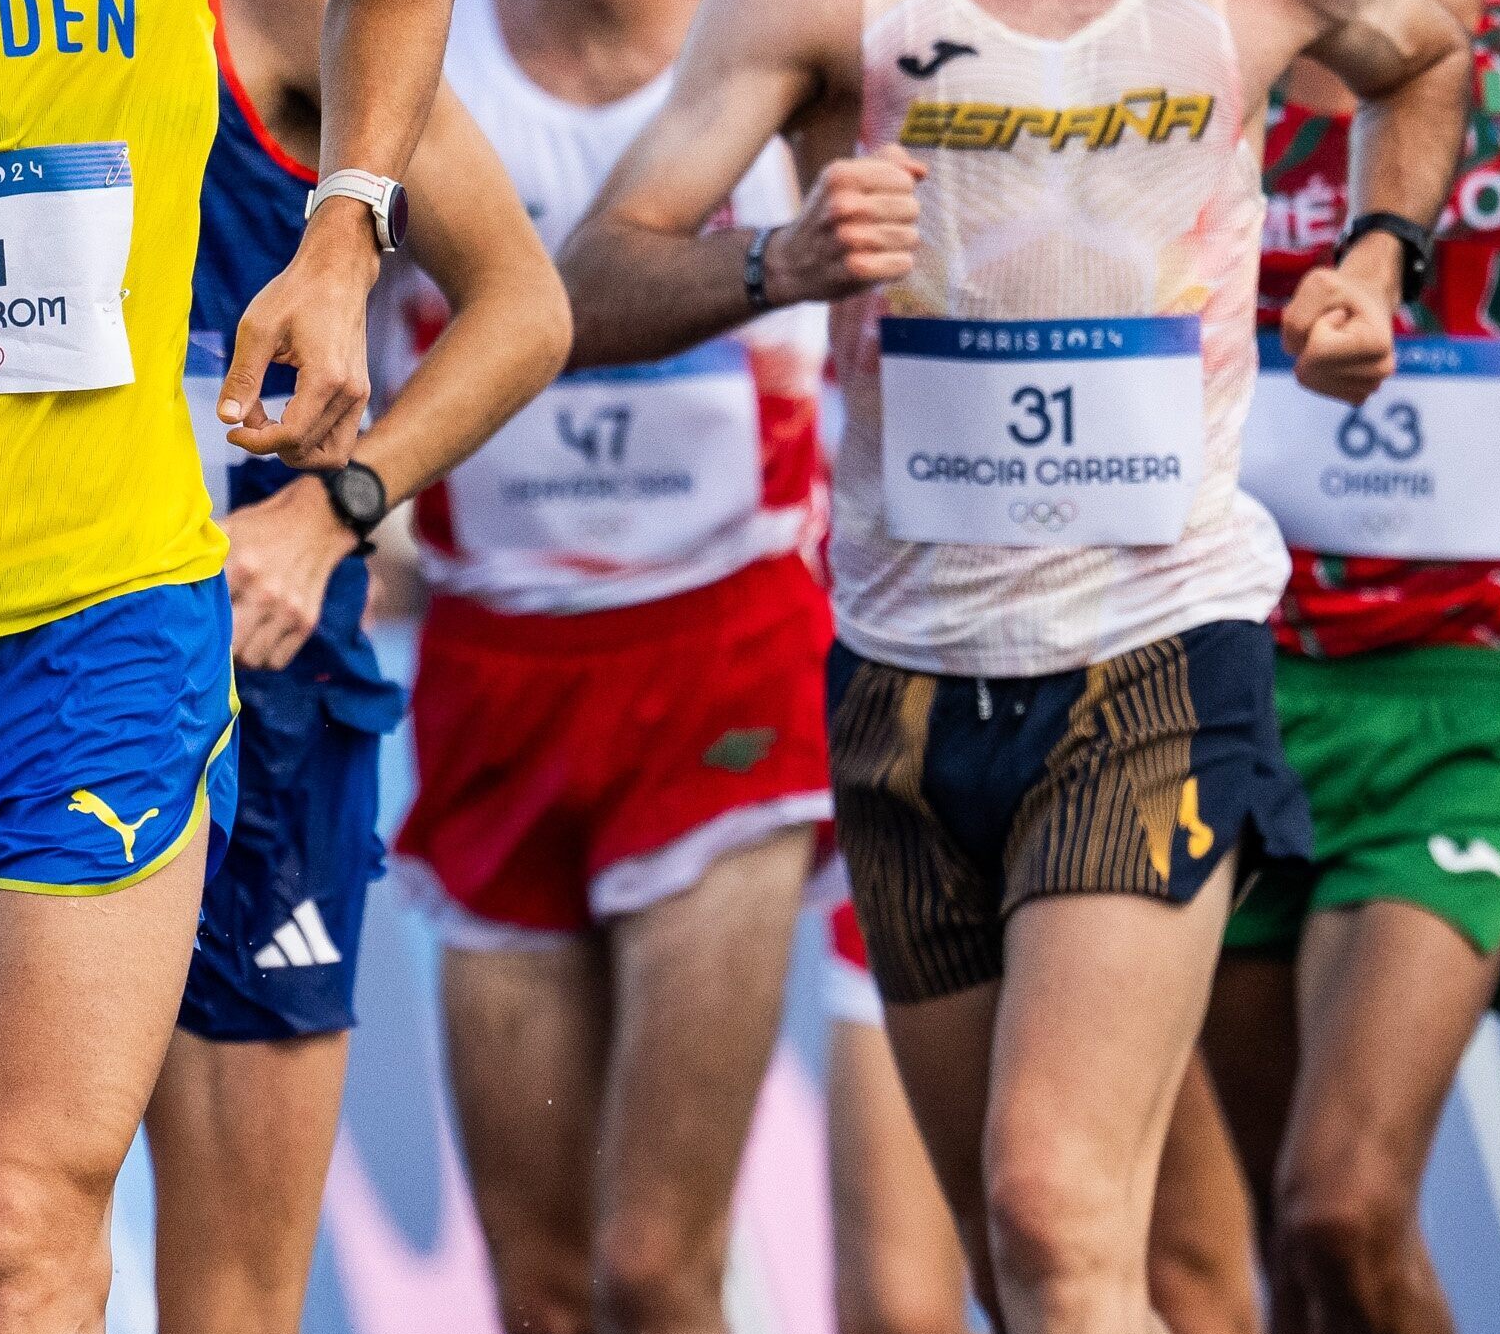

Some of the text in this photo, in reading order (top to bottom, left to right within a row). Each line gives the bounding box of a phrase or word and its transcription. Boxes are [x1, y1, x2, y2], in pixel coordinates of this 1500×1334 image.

[899, 87, 1216, 152] ESPAÑA
[958, 326, 1041, 353] PARIS
[555, 404, 634, 464] 47
[1006, 385, 1076, 447] 31
[1336, 400, 1424, 461] 63
[907, 452, 1183, 487] GARCIA CARRERA
